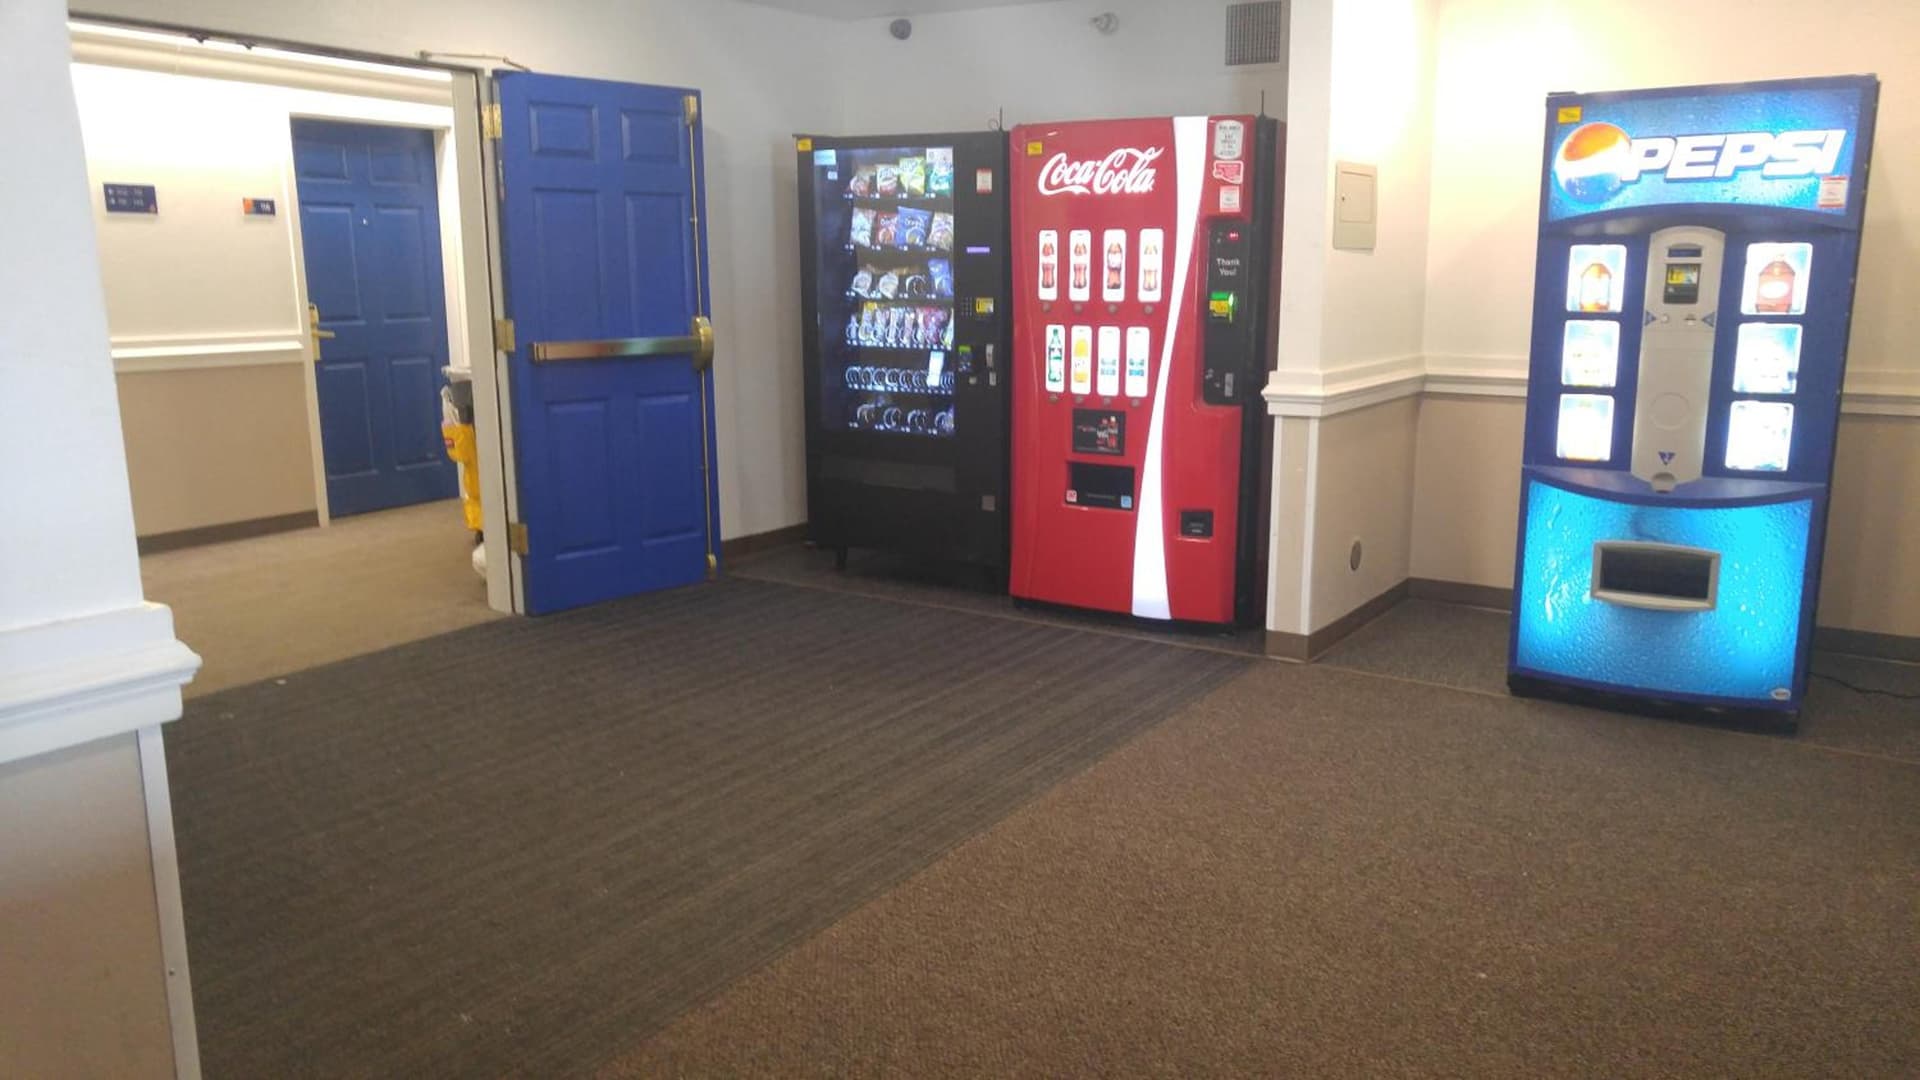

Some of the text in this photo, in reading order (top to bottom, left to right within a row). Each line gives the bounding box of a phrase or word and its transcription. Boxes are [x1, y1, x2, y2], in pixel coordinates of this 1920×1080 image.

[1037, 146, 1166, 196] Coca-Cola
[1617, 128, 1848, 184] PEPSI
[1216, 257, 1241, 267] Thank
